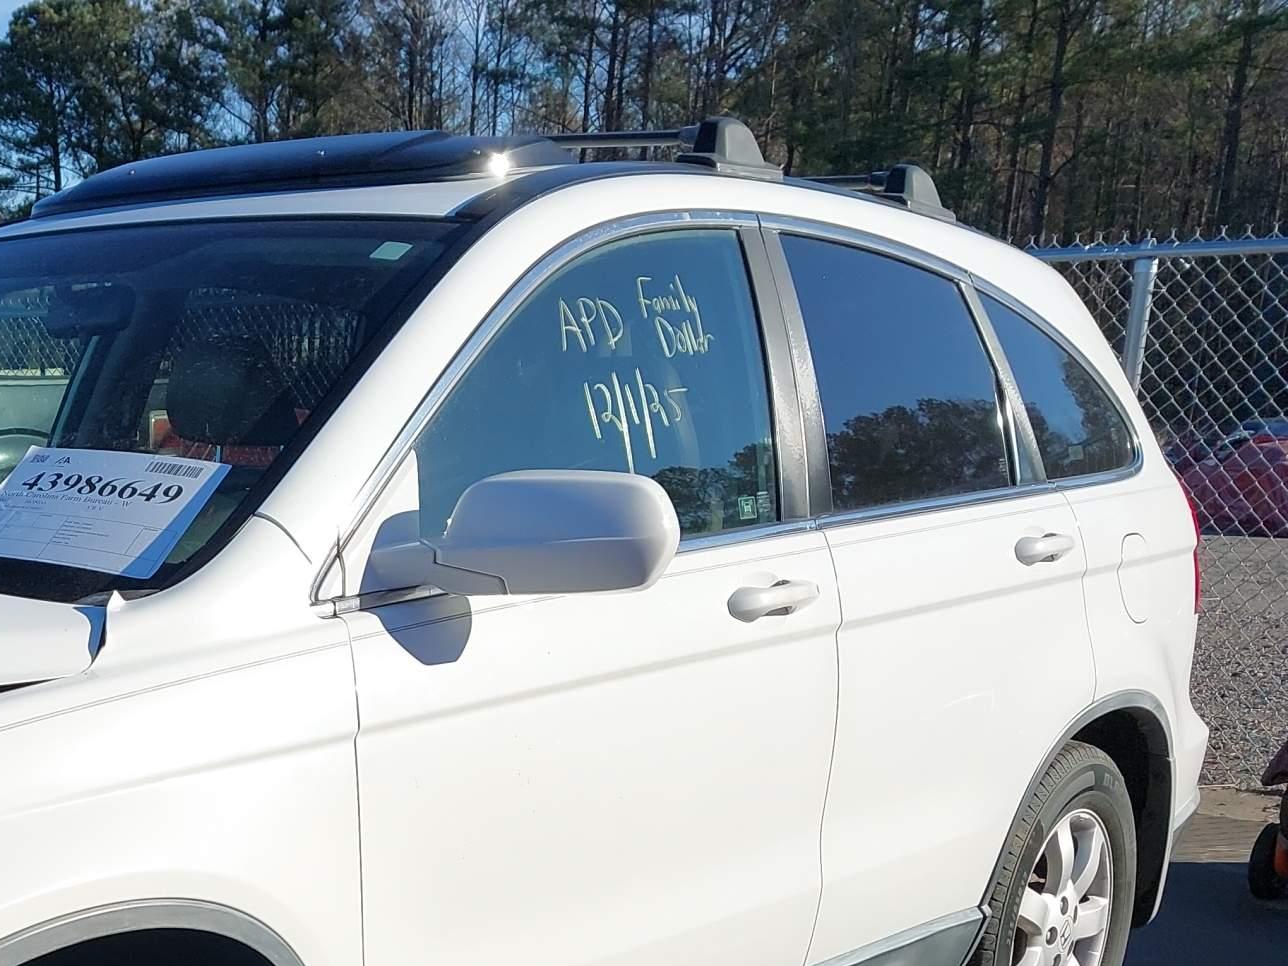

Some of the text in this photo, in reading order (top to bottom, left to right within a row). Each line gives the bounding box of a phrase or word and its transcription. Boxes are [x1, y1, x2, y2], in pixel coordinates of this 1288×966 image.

[559, 274, 703, 352] APD Family
[655, 316, 715, 358] Dollar
[583, 367, 689, 474] 12/1/25
[21, 471, 185, 505] 43986649
[25, 491, 59, 500] Carolina
[60, 494, 82, 502] Farm
